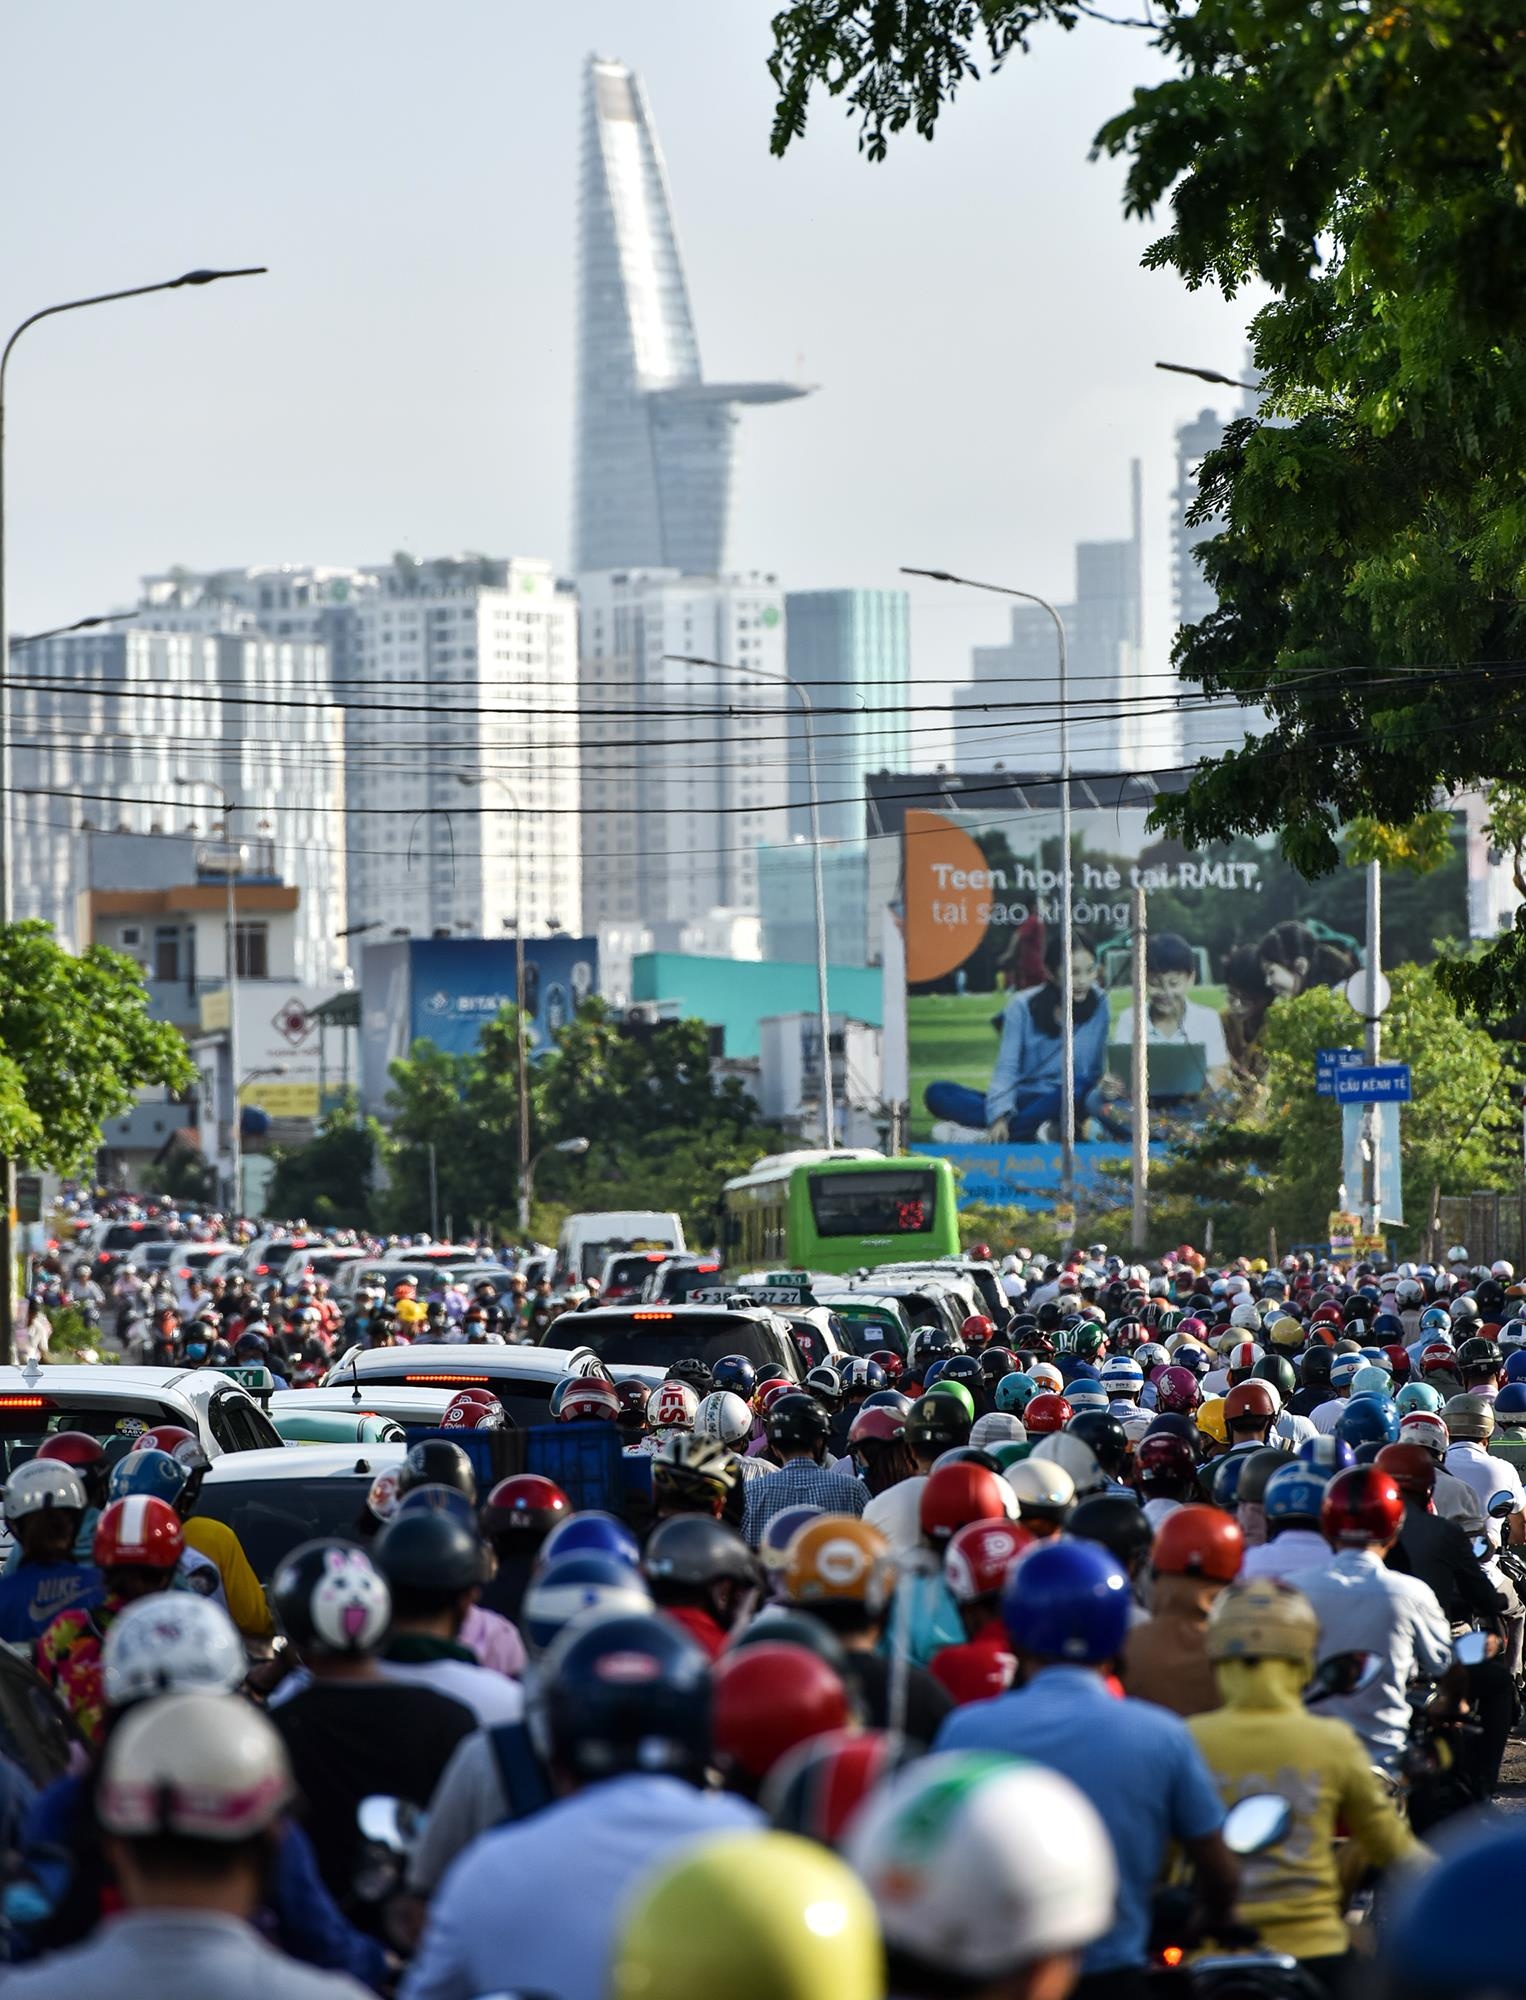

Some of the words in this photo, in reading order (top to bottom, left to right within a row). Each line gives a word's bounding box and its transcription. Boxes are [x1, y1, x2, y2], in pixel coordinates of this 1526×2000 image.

[931, 863, 1007, 890] Teen
[1083, 863, 1121, 890] hè
[1178, 861, 1263, 893] RMIT,
[976, 902, 1029, 925] sao
[774, 1275, 801, 1286] TAXI
[759, 1292, 777, 1303] 27
[780, 1292, 799, 1303] 27
[37, 1574, 82, 1602] NIKE
